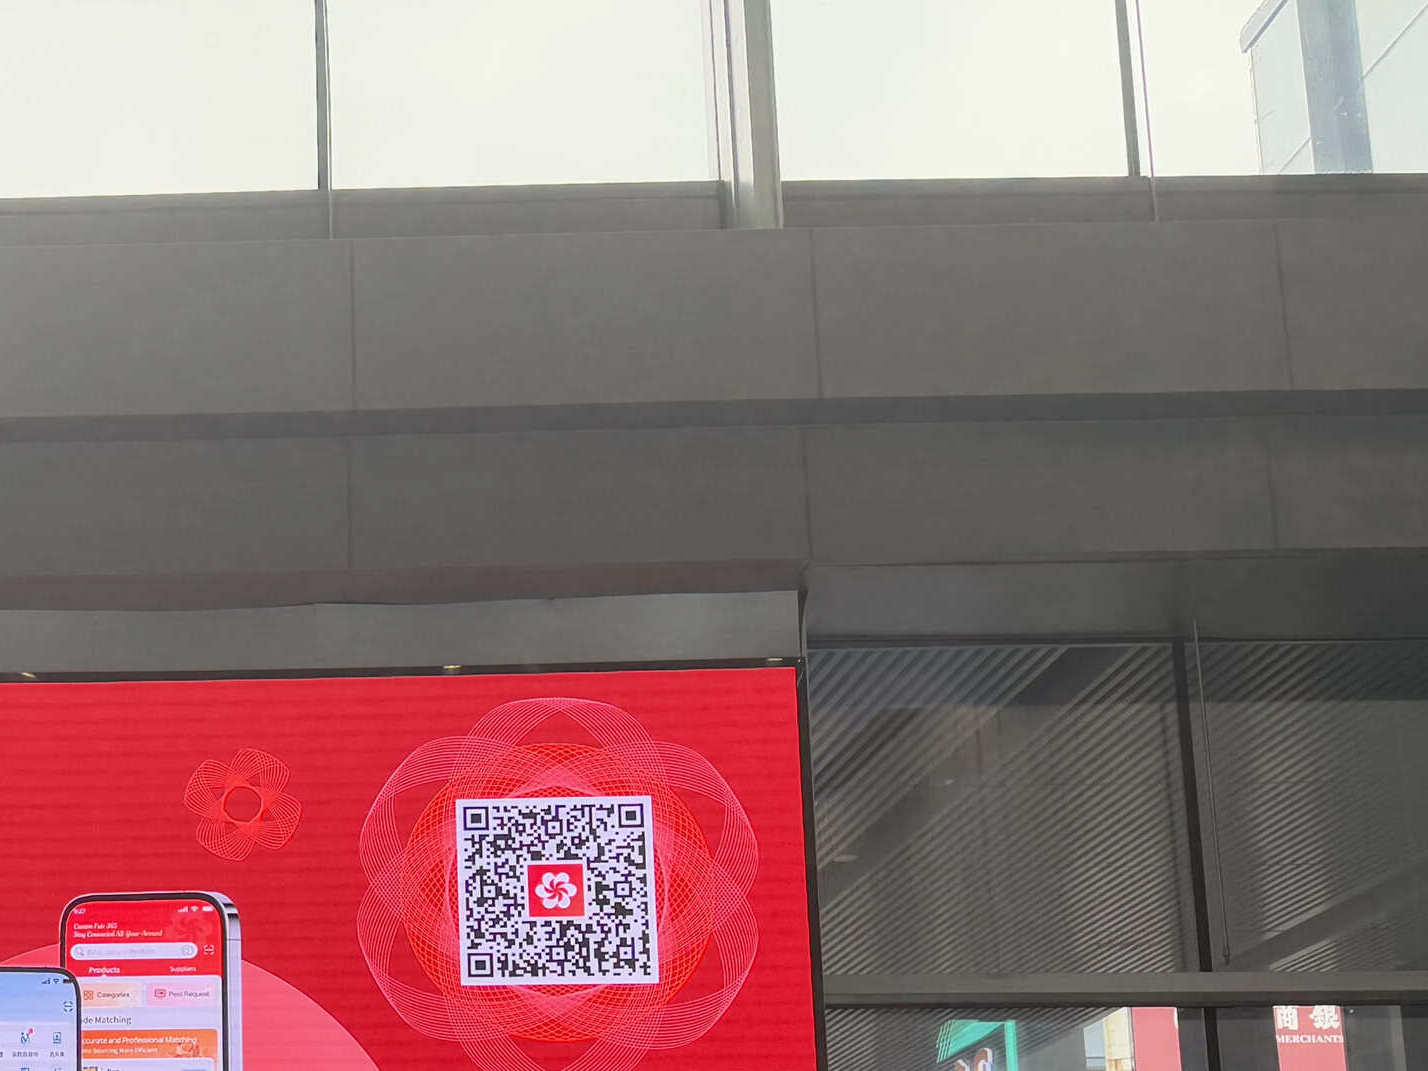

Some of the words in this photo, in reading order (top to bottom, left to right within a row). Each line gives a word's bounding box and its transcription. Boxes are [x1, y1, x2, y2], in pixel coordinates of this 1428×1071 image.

[88, 966, 120, 974] Products
[169, 965, 197, 973] Suppliers
[97, 991, 130, 999] Categories
[95, 1016, 132, 1025] Matching
